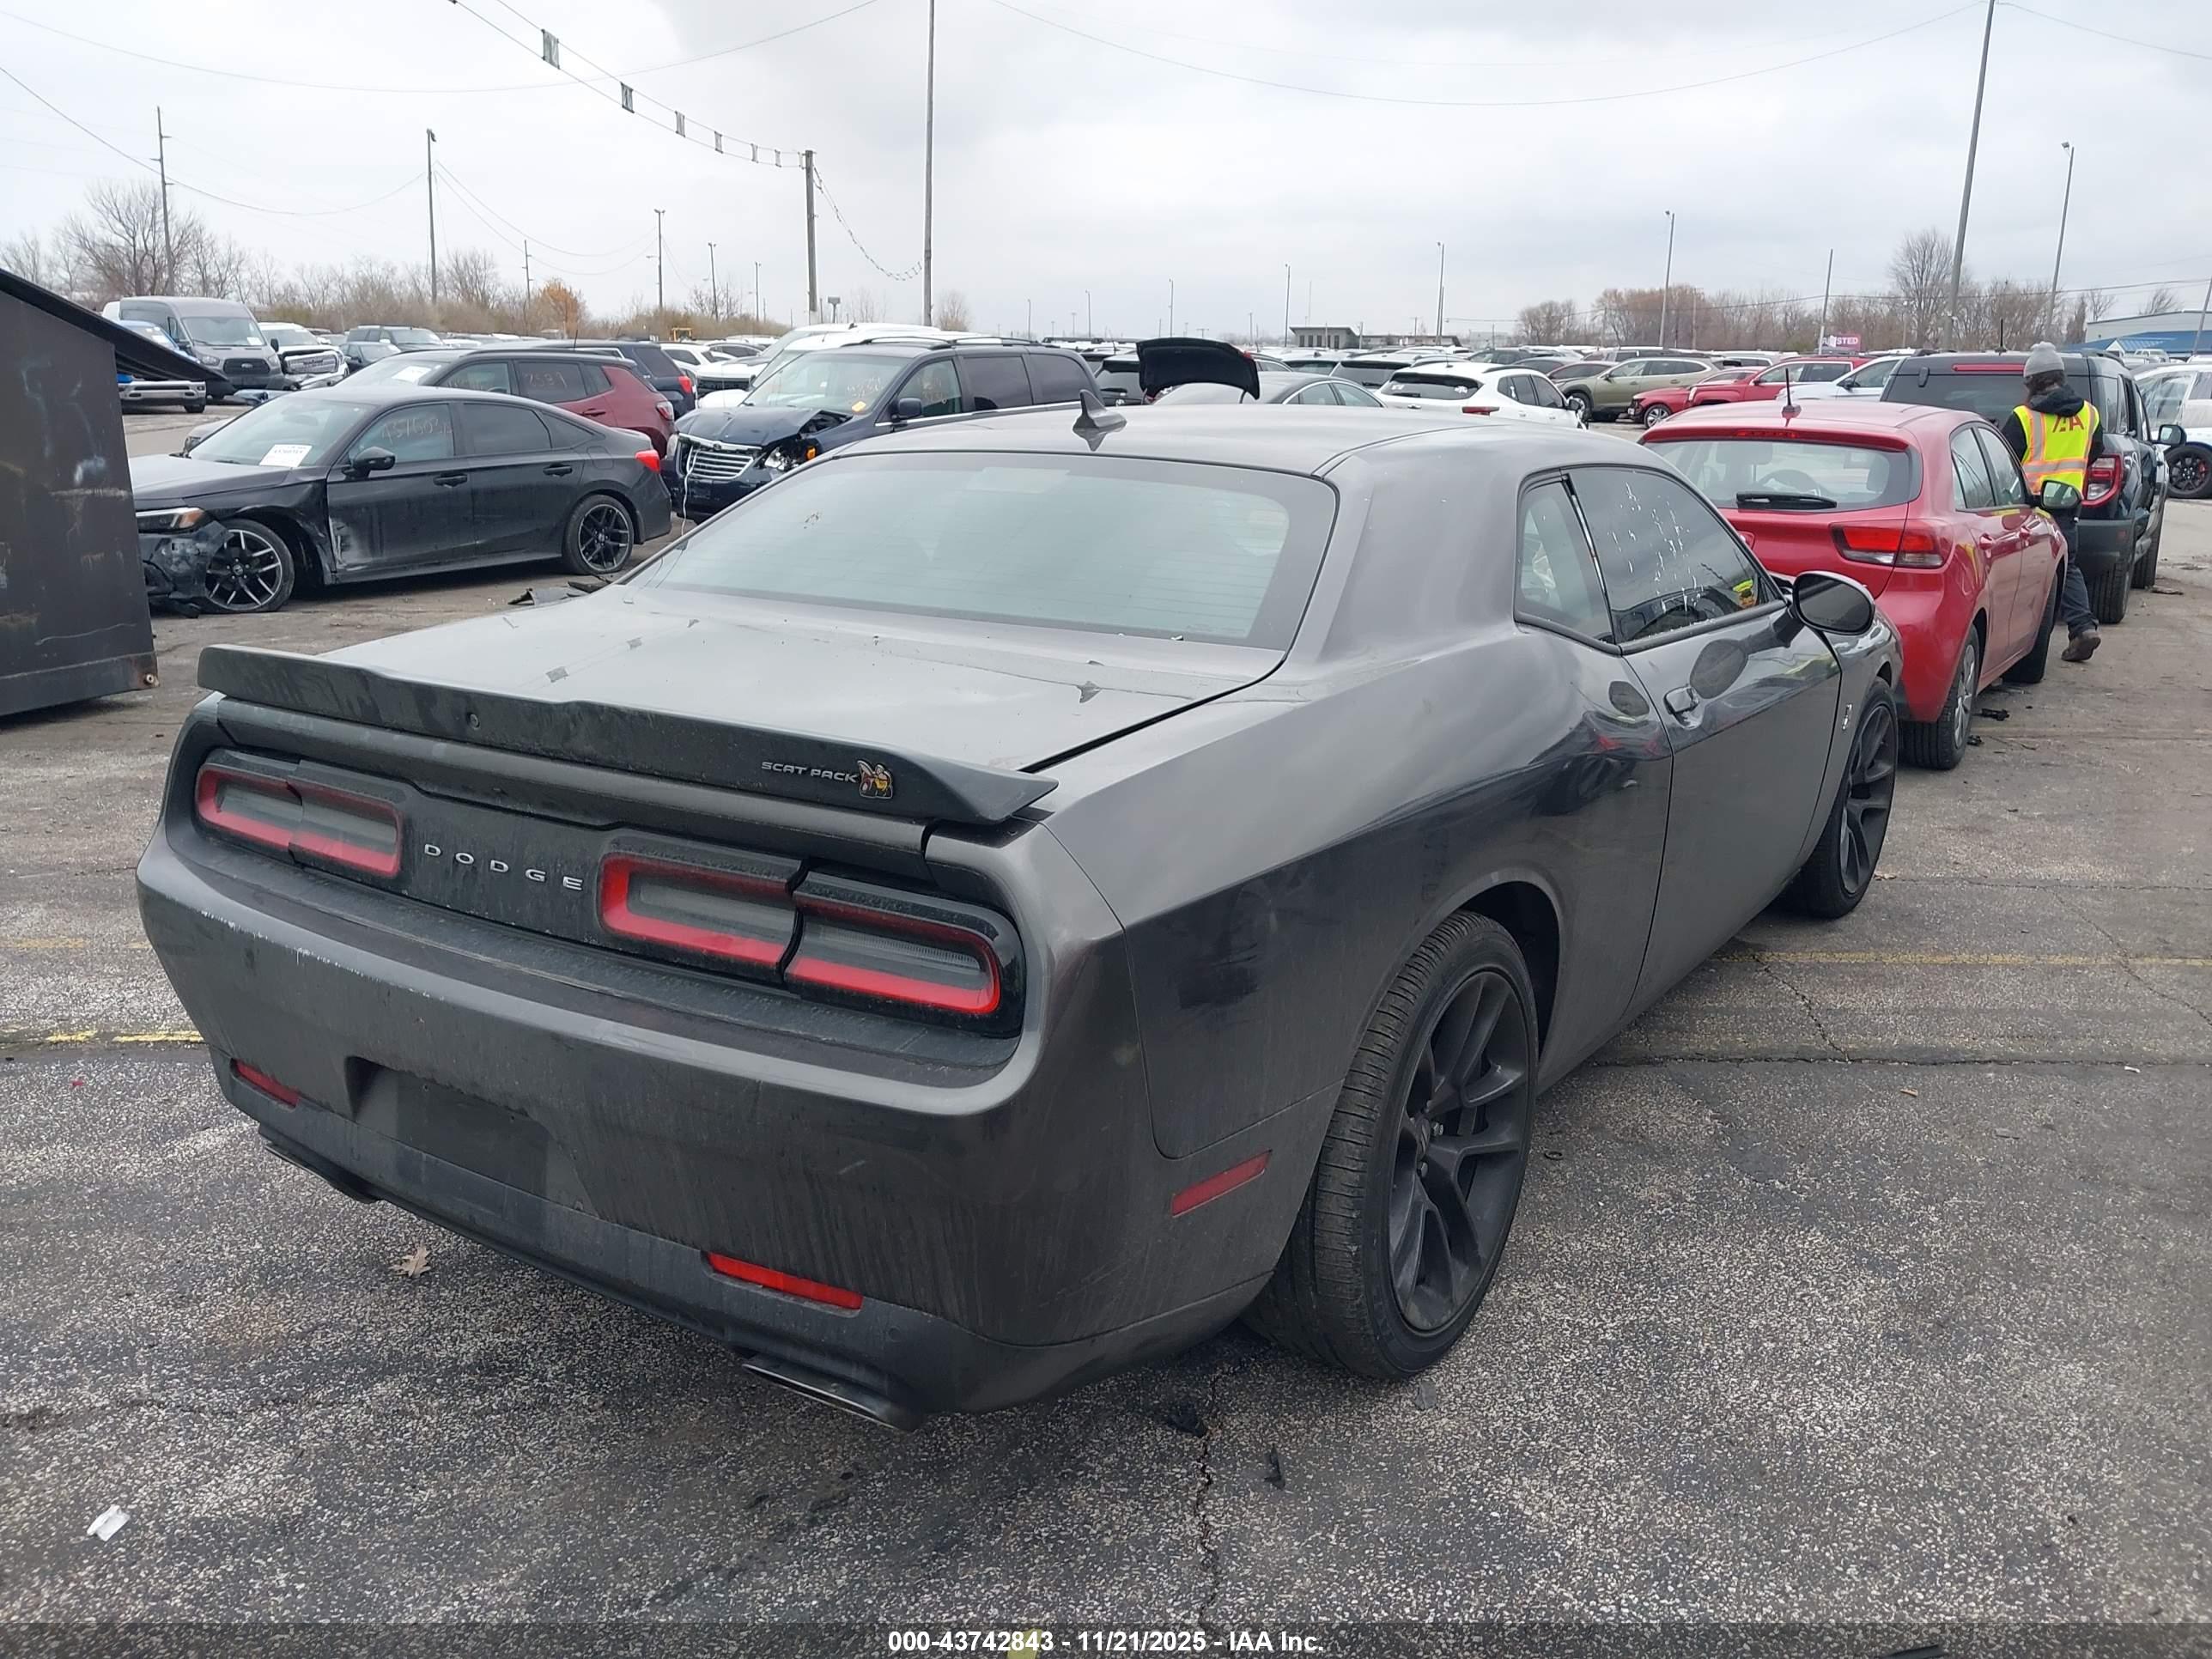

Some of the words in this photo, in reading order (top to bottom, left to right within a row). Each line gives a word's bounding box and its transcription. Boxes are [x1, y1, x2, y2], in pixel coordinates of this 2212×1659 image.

[761, 761, 807, 775] SCAT
[810, 768, 858, 784] PACK
[424, 843, 584, 891] DODGE
